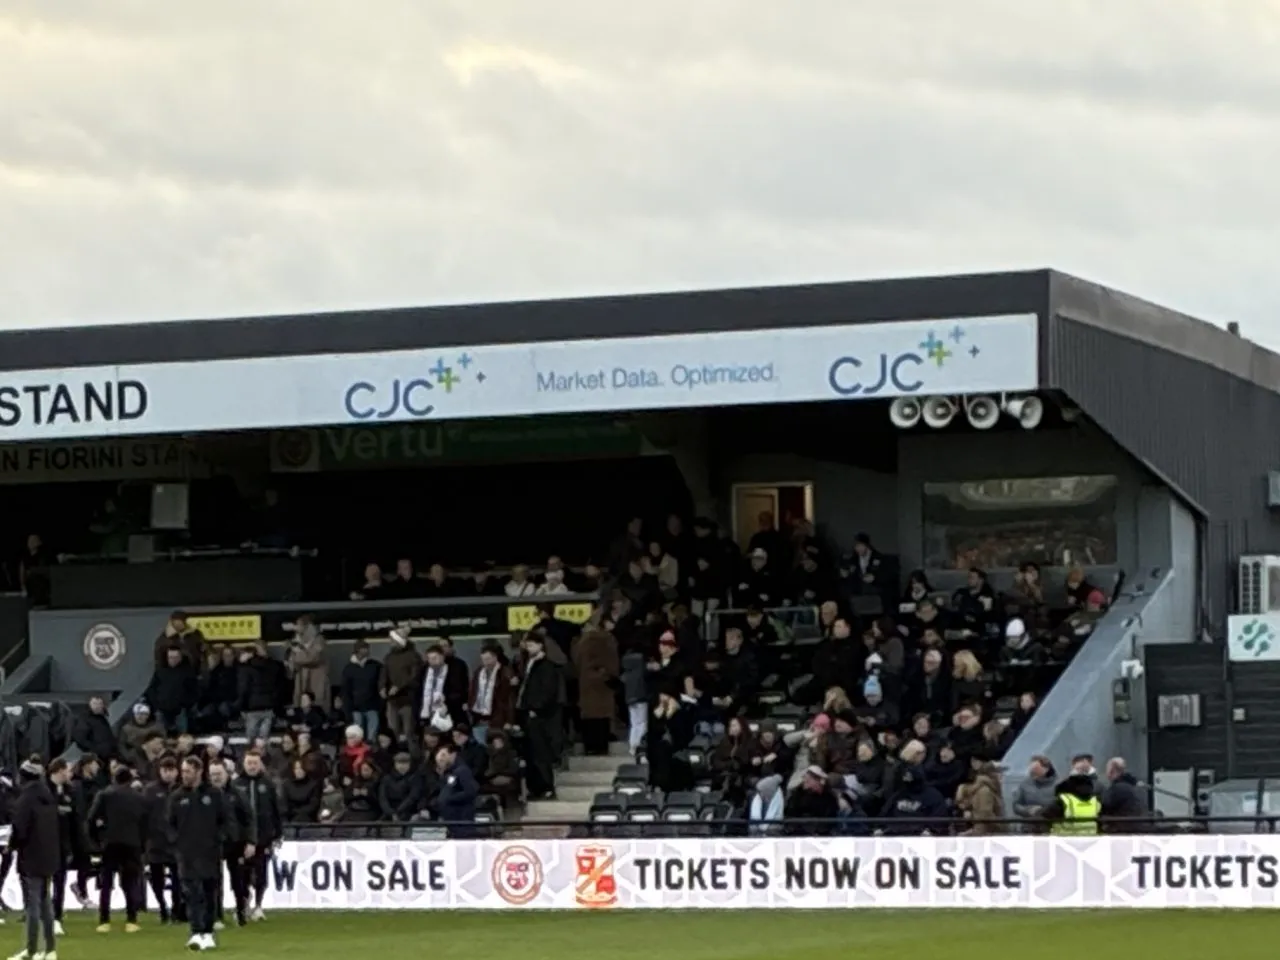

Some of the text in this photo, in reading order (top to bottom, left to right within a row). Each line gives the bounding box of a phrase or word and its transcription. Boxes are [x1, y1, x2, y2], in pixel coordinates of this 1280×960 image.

[536, 363, 778, 392] Market Data. Optimized.
[828, 352, 924, 395] CJC
[344, 378, 434, 419] CJC
[26, 445, 124, 471] FIORINI
[310, 859, 353, 892] ON
[366, 859, 446, 892] SALE
[633, 856, 1021, 891] TICKETS NOW ON SALE
[1130, 855, 1278, 889] TICKETS
